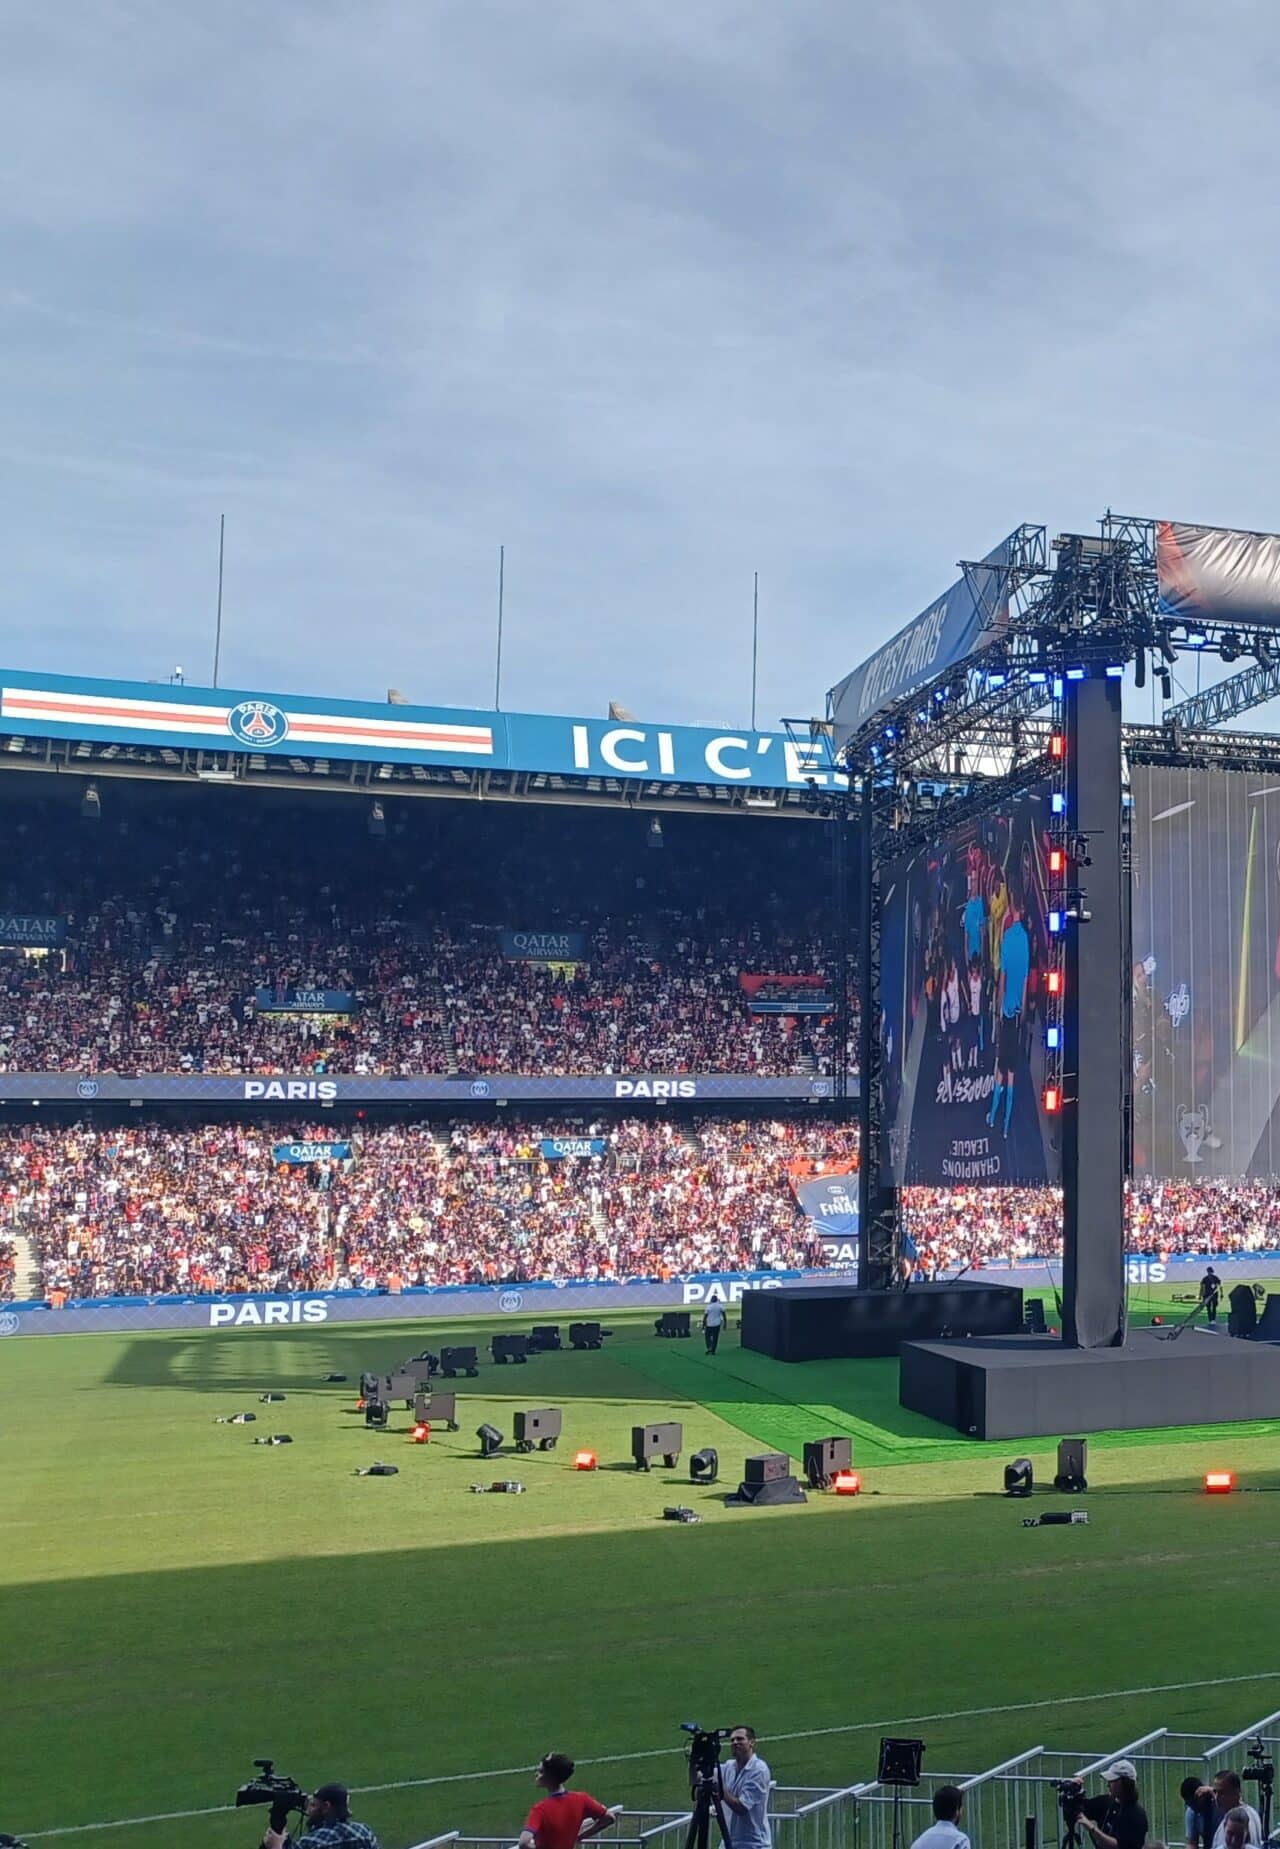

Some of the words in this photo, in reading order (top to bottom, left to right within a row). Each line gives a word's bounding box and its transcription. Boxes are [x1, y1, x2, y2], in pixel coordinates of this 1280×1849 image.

[238, 703, 278, 717] PARIS
[572, 725, 675, 776] ICI
[513, 934, 569, 950] QATAR
[244, 1081, 337, 1100] PARIS
[615, 1080, 697, 1098] PARIS
[290, 1145, 331, 1158] QATAR
[553, 1141, 591, 1153] QATAR
[952, 1138, 989, 1156] LEAGUE
[942, 1156, 1000, 1178] CHAMPIONS
[820, 1201, 859, 1217] FINAL
[1125, 1262, 1167, 1283] RIS
[209, 1299, 329, 1326] PARIS
